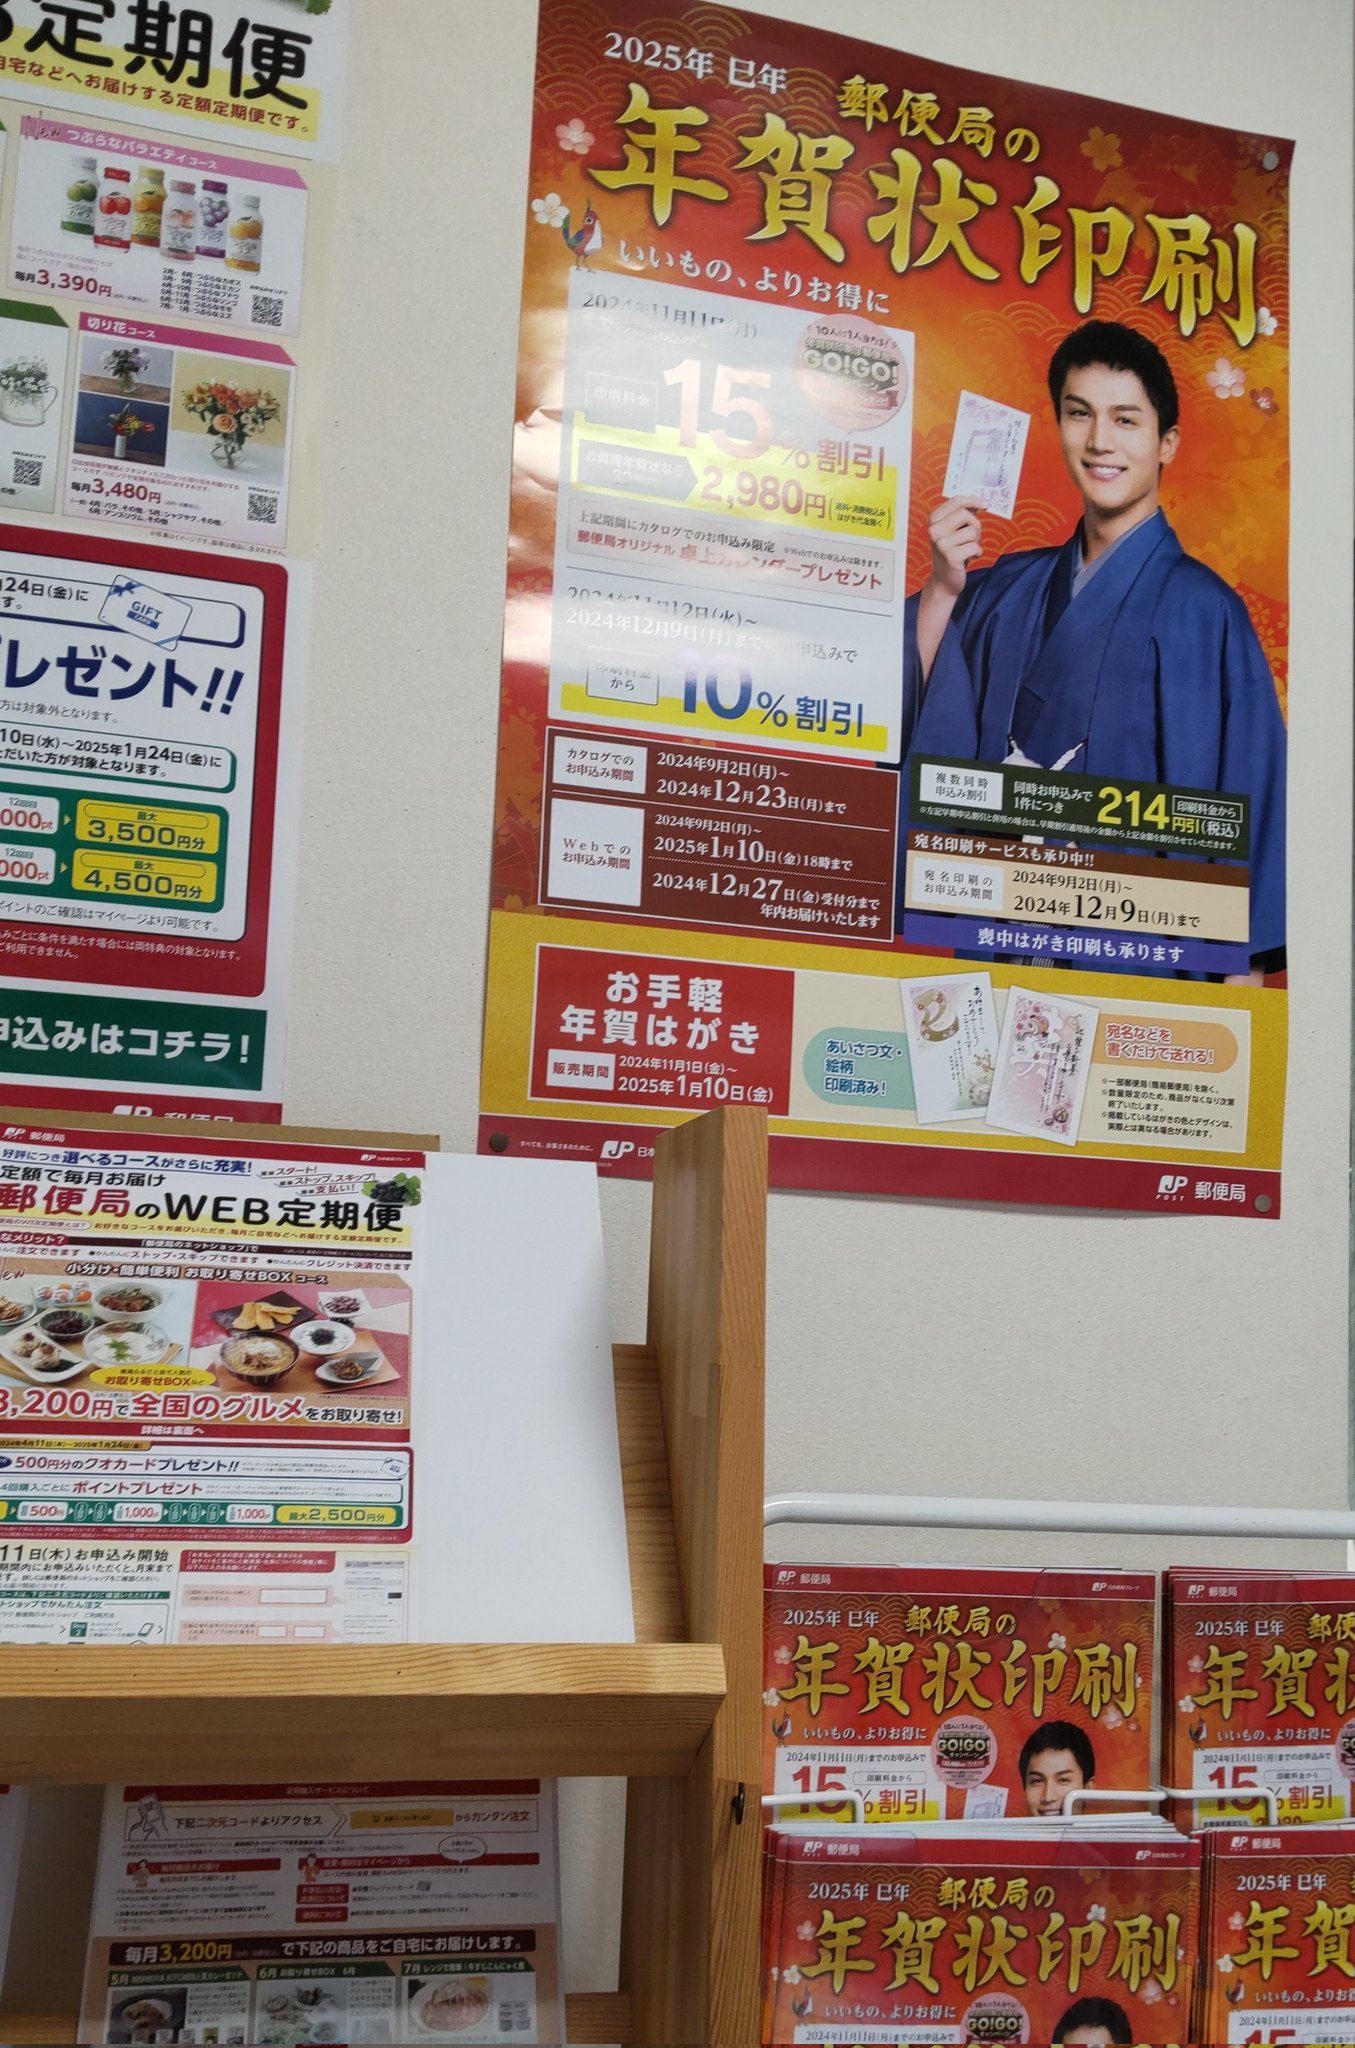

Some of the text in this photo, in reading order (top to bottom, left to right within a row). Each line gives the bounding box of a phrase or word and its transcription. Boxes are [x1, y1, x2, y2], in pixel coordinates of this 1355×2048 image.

[0, 0, 313, 110] 定期便
[604, 32, 788, 95] 2025年 巳年
[836, 74, 1041, 163] 郵便局の
[66, 129, 218, 170] つぶらなバラエティコース
[588, 82, 1258, 347] 年賀状印刷
[15, 269, 112, 297] 毎月3,390円
[618, 239, 890, 314] いいもの、よりお得に
[87, 319, 156, 343] 切り花コース
[803, 348, 901, 386] GO!GO!
[71, 478, 161, 504] 毎月3,480円
[701, 464, 826, 520] 2,980円
[576, 529, 676, 556] 郵便局オリジナル
[578, 510, 776, 554] 上記期間にカタログでのお申込み限定
[0, 576, 90, 602] 24日(金)に
[131, 600, 163, 621] GIFT
[0, 634, 245, 716] レゼント!!
[610, 677, 635, 692] から
[675, 649, 863, 738] 10%割引
[566, 748, 635, 766] カタログでの
[657, 751, 790, 780] 2024年9月2日(月)～
[565, 763, 634, 783] お申込み期間
[935, 770, 989, 790] 複数同時
[656, 778, 848, 815] 2024年12月23日(月)まで
[935, 786, 988, 804] 申込み割引
[1013, 780, 1093, 802] 同時お申込みで
[1014, 796, 1064, 815] 1件につき
[1176, 800, 1237, 818] 印刷料金から
[137, 811, 157, 822] 最大
[655, 813, 763, 836] 2024年9月2日(月)～
[88, 819, 206, 850] 3,500円分
[654, 835, 853, 872] 2025年1月10日(金)18時まで
[913, 832, 1095, 867] 宛名印刷サービスも承り中!!
[134, 860, 154, 871] 最大
[562, 851, 631, 871] お申込み期間
[84, 869, 203, 900] 4,500円分
[924, 868, 993, 887] 宛名印刷の
[1012, 869, 1134, 894] 2024年9月2日(月)～
[652, 872, 881, 911] 2024年12月27日(金)受付分まで
[923, 882, 992, 901] お申込み期間
[760, 903, 881, 929] 年内お届けいたします
[1013, 893, 1201, 928] 2024年12月9日(月)まで
[977, 926, 1185, 964] 喪中はがき印刷も承ります
[606, 970, 724, 1014] お手軽
[559, 1004, 760, 1055] 年賀はがき
[1106, 1022, 1172, 1044] 宛名などを
[826, 1038, 903, 1060] あいさつ文・
[1106, 1042, 1215, 1065] 書くだけで送れる!
[552, 1060, 610, 1079] 販売期間
[619, 1054, 738, 1076] 2024年11月1日(金)～
[825, 1058, 854, 1075] 絵柄
[618, 1074, 774, 1105] 2025年1月10日(金)
[824, 1077, 887, 1096] 印刷済み!
[1107, 1100, 1164, 1112] 終了いたします。
[29, 1131, 66, 1143] 郵便局
[1107, 1122, 1213, 1139] 実際とは異なる場合があります。
[600, 1140, 635, 1160] JP
[0, 1165, 166, 1188] 定額で毎月お届け
[1156, 1194, 1187, 1202] POST
[1158, 1174, 1247, 1203] JP 郵便局
[0, 1183, 404, 1233] 郵便局のWEB定期便
[66, 1263, 329, 1285] 小分け・簡単便利 お取り寄せBOX コース
[141, 1425, 205, 1436] 詳細は裏面へ
[14, 1456, 240, 1472] 500円分のクオカードプレゼント!!
[72, 1482, 203, 1495] ポイントプレゼント
[289, 1508, 385, 1522] 最大2,500円分
[800, 1573, 832, 1586] 郵便局
[1208, 1586, 1238, 1598] 郵便局
[783, 1609, 880, 1629] 2025年 巳年
[903, 1604, 1017, 1638] 郵便局の
[1194, 1620, 1285, 1637] 2025年 巳年
[777, 1635, 1138, 1719] 年賀状印刷
[803, 1726, 927, 1741] いいもの、よりお得に
[1217, 1728, 1332, 1742] いいもの、よりお得に
[936, 1738, 992, 1752] GO!GO!
[786, 1751, 927, 1763] 2024年11月11日(月)までのお申込みで
[1203, 1751, 1332, 1764] 2024年11月11日(月)までのお申込みで
[866, 1774, 912, 1783] 印刷料金から
[174, 1810, 530, 1830] 下記二次元コードよりアクセス からカンタン注文
[826, 1844, 860, 1857] 郵便局
[1252, 1838, 1282, 1850] 郵便局
[808, 1882, 910, 1902] 2025年 巳年
[1236, 1874, 1327, 1892] 2025年 巳年
[937, 1876, 1056, 1912] 郵便局の
[125, 1935, 521, 1965] 毎月3,200円 で下記の商品をご自宅にお届けします。
[800, 1909, 1181, 1994] 年賀状印刷
[259, 1968, 277, 1979] 6月
[404, 1961, 421, 1974] 7月
[111, 1974, 129, 1986] 5月
[824, 2004, 957, 2020] いいもの、よりお得に
[805, 2030, 955, 2043] 2024年11月11日(月)までのお申込みで
